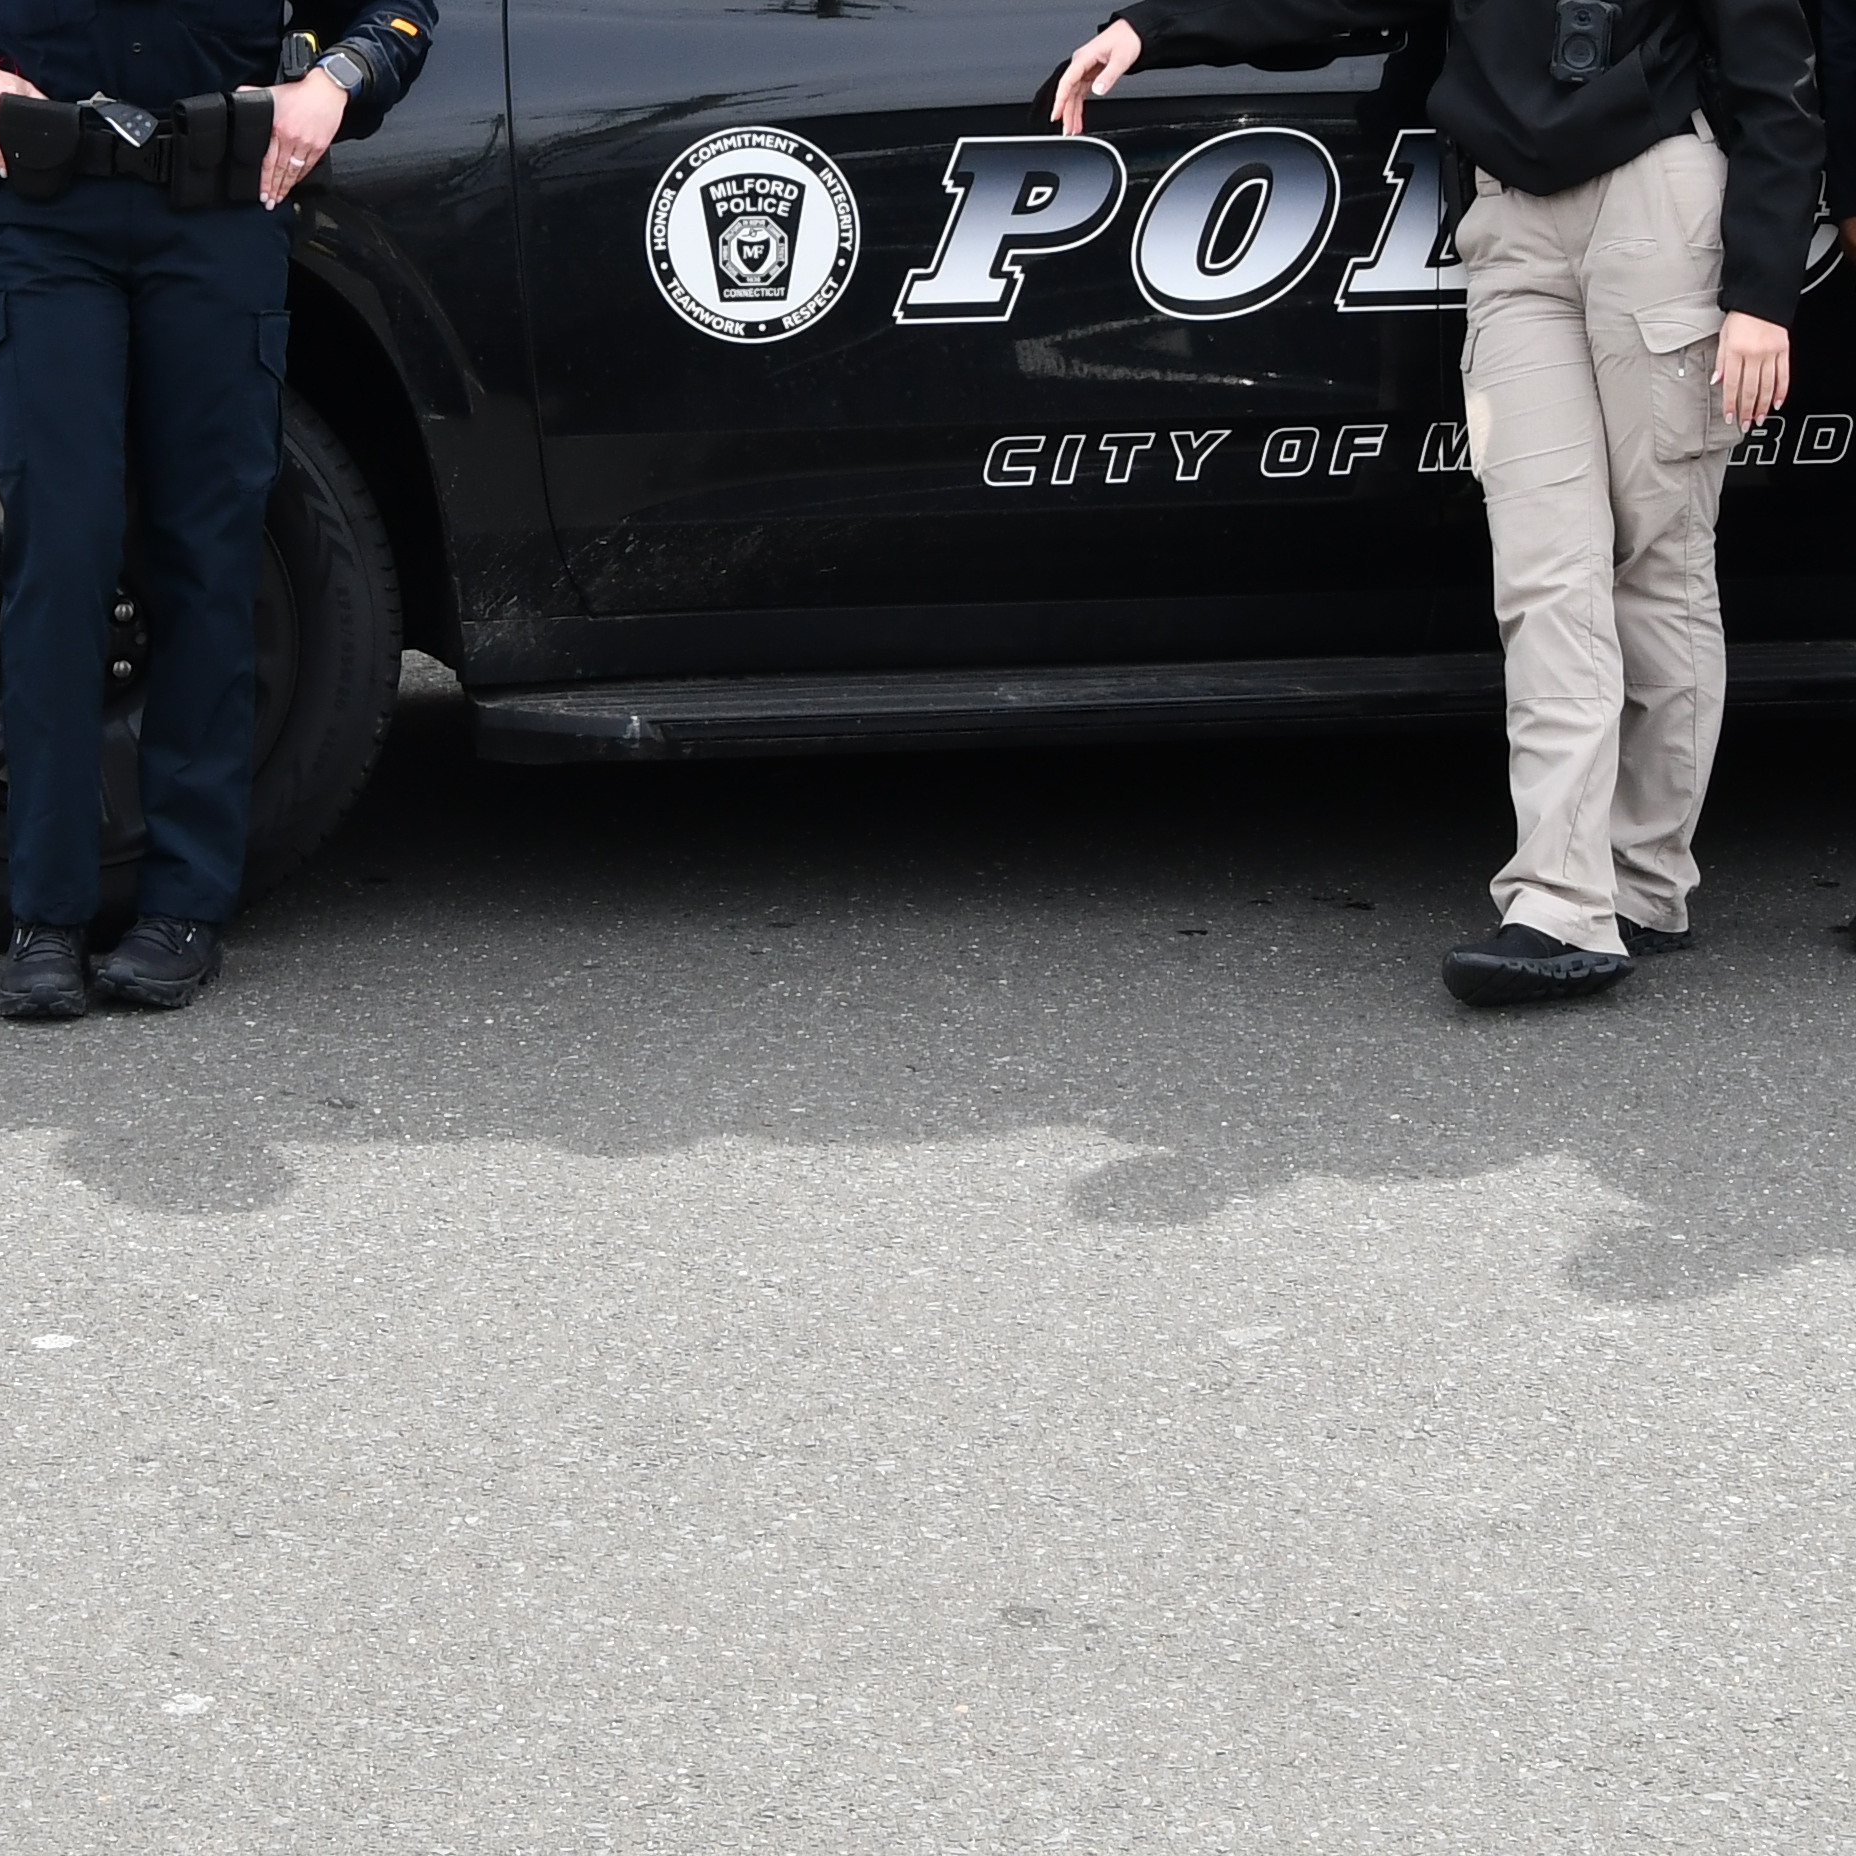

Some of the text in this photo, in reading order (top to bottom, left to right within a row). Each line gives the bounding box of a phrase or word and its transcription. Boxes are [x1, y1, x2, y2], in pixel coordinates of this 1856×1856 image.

[688, 133, 799, 168] COMMITMENT
[709, 178, 799, 201] MILFORD
[715, 197, 792, 218] POLICE
[818, 167, 853, 252] INTEGRITY
[653, 187, 677, 251] HONOR
[893, 126, 1844, 325] POL
[666, 276, 746, 336] TEAMWORK
[723, 286, 786, 299] CONNECTICUT
[781, 276, 840, 330] RESPECT
[983, 428, 1232, 487] CITY
[1260, 422, 1389, 478] OF
